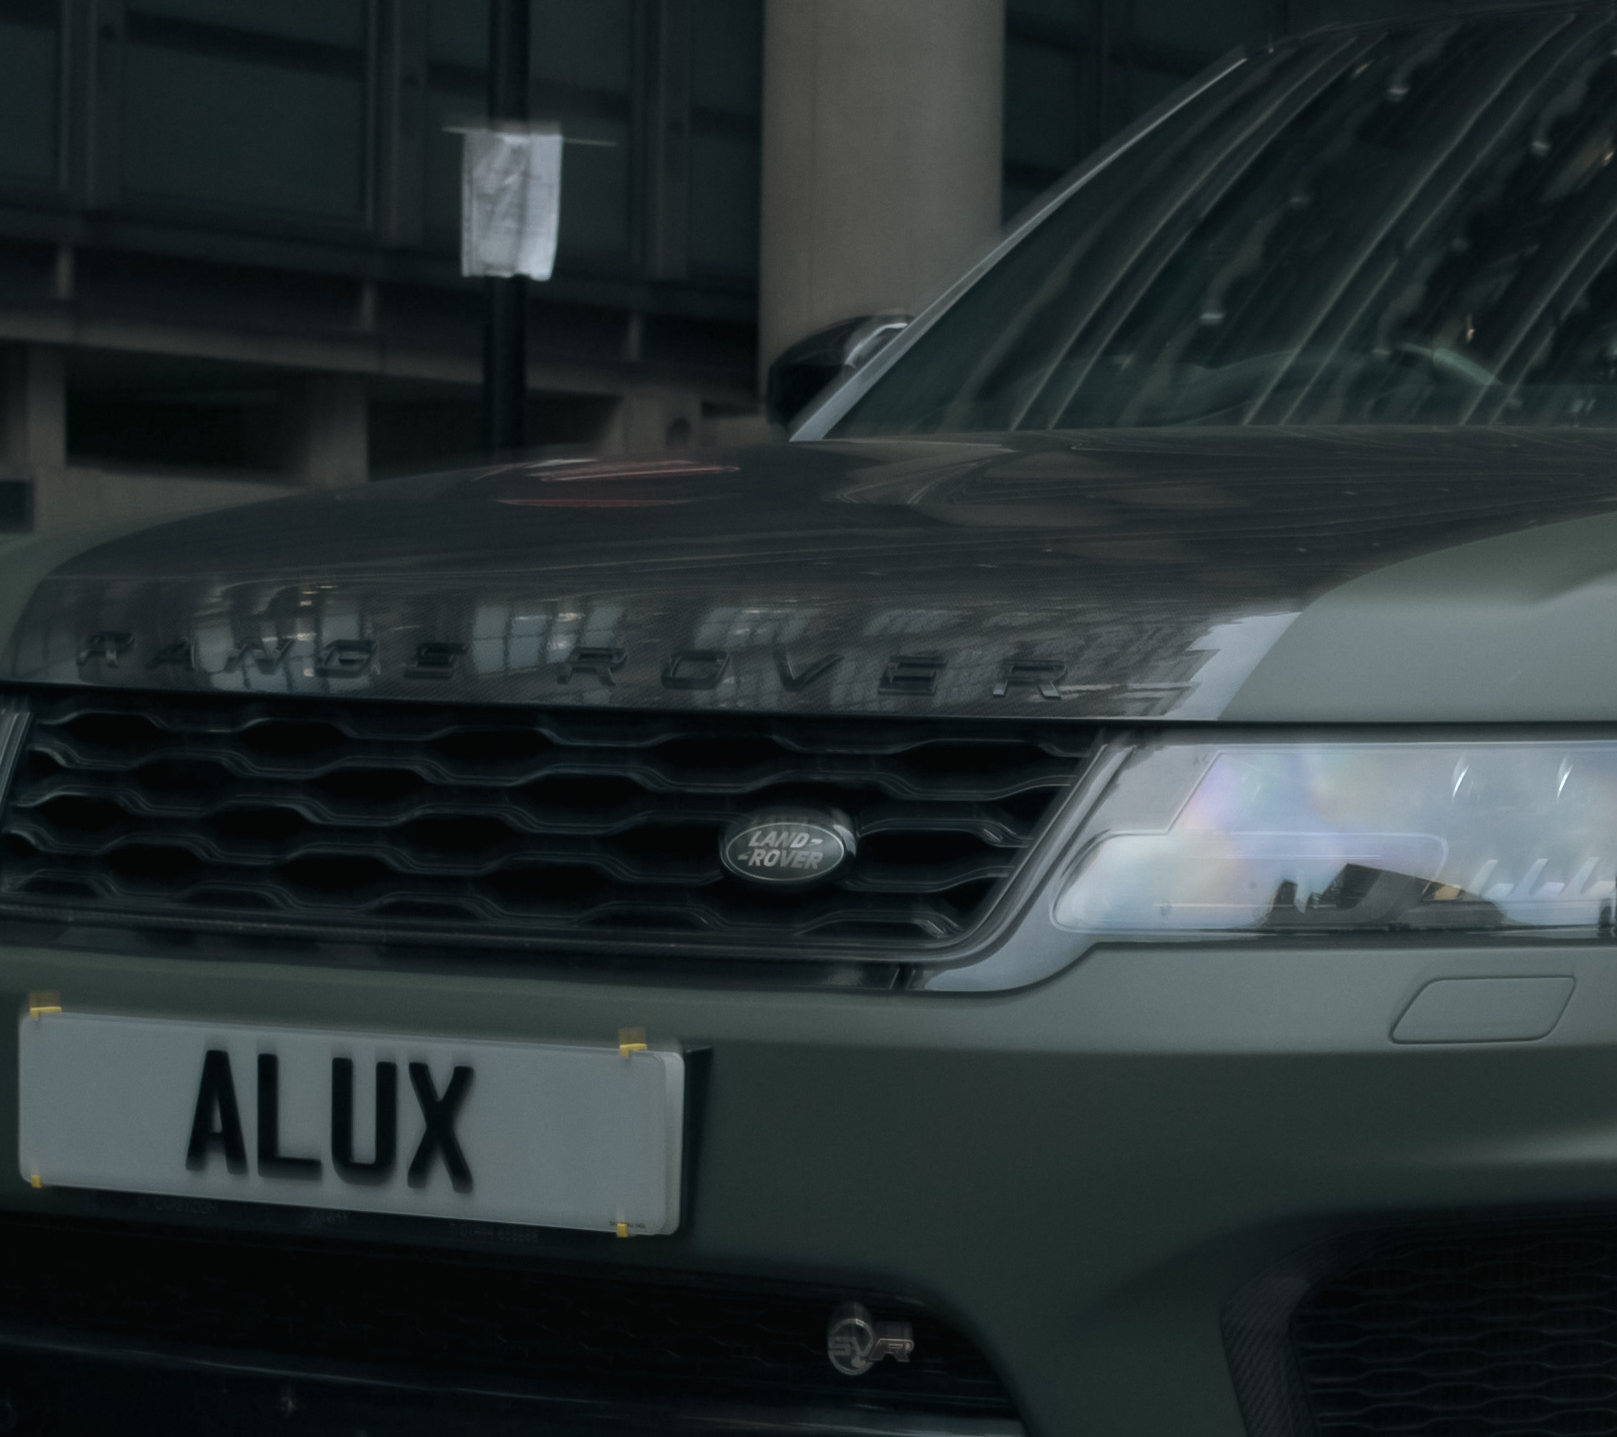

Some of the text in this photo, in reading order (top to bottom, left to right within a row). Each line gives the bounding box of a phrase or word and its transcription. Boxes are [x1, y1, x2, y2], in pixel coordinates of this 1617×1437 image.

[76, 629, 1065, 702] RANGE ROVER
[747, 830, 811, 849] LAND
[747, 848, 825, 870] ROVER
[185, 1049, 476, 1195] ALUX
